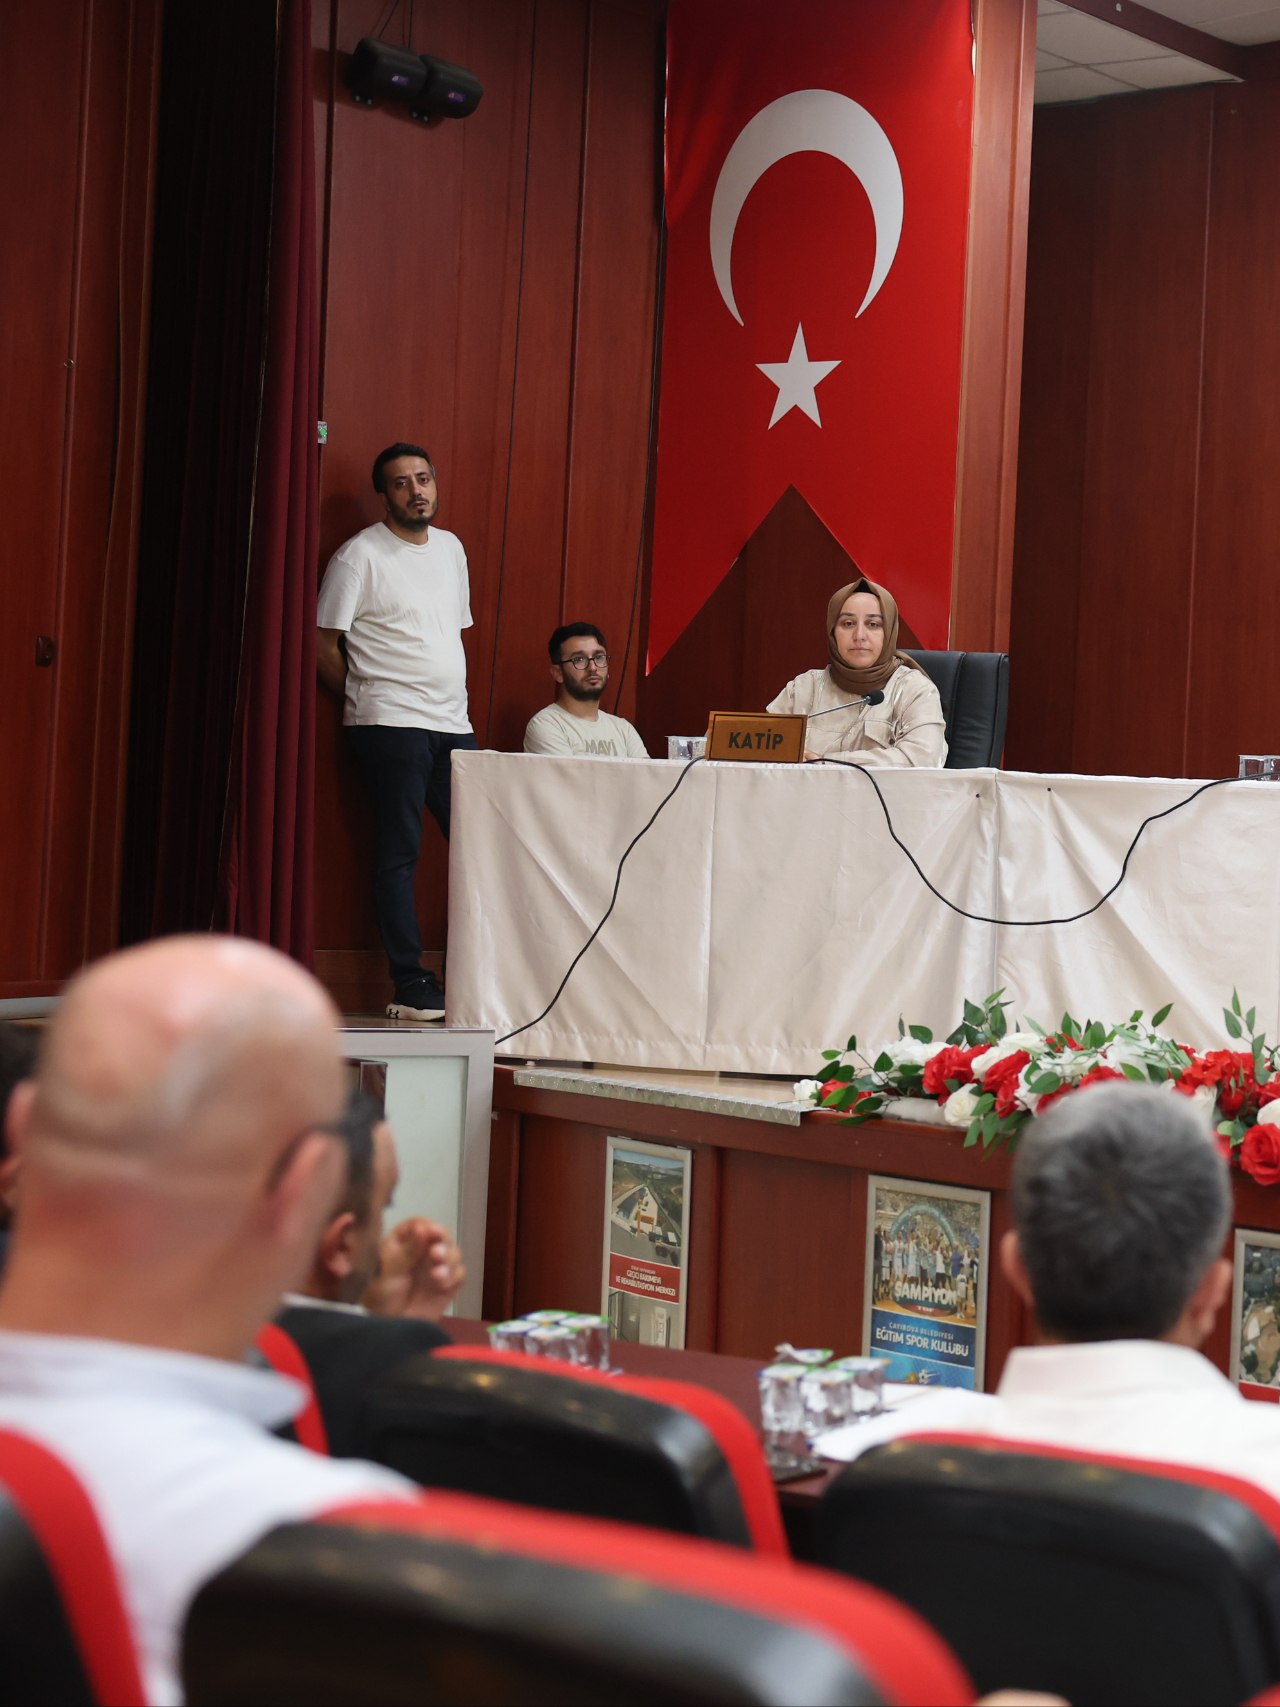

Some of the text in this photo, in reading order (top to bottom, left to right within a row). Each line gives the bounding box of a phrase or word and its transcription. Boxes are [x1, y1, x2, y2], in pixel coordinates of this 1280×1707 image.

[727, 728, 784, 751] KATİP
[875, 1325, 904, 1344] EĞİTİM
[906, 1334, 929, 1348] SPOR
